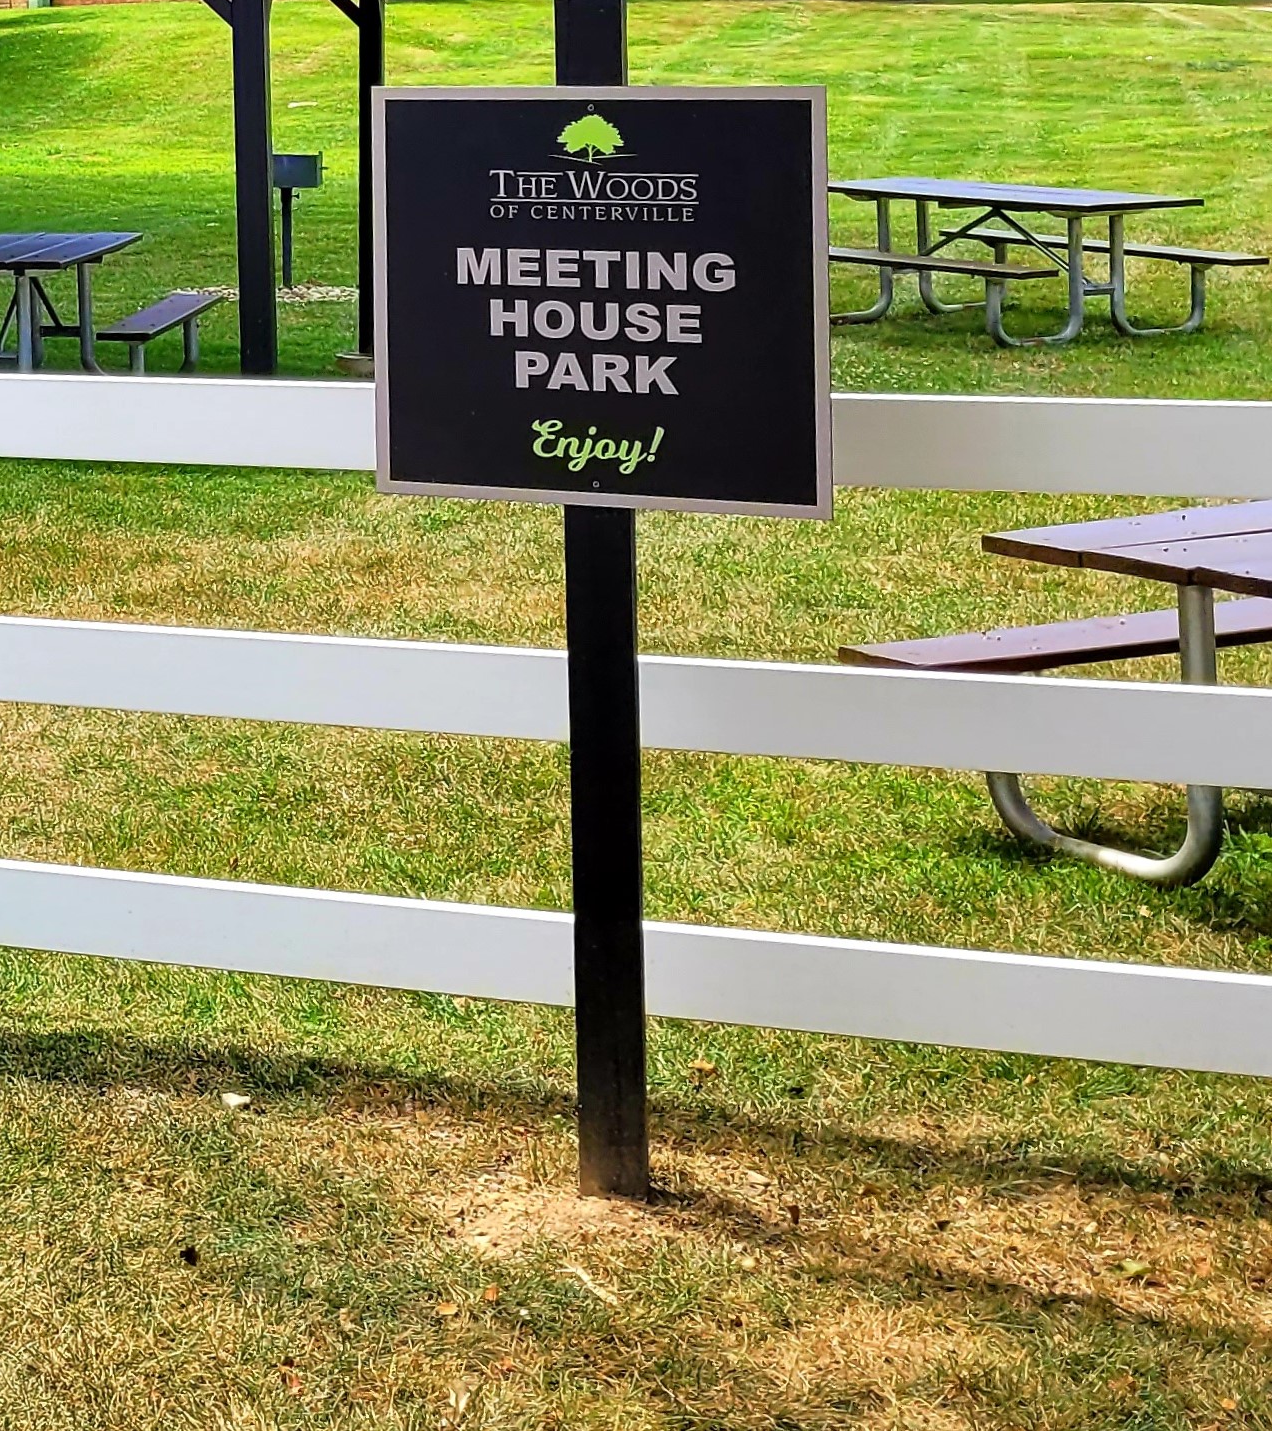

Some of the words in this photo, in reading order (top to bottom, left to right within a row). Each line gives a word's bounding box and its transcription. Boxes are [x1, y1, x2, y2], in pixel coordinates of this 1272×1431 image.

[489, 170, 558, 199] THE
[565, 171, 697, 200] WOODS
[490, 205, 520, 219] OF
[531, 205, 695, 222] CENTERVILLE
[456, 247, 737, 292] MEETING
[490, 300, 702, 344] HOUSE
[515, 351, 679, 395] PARK
[531, 419, 665, 476] Enjoy!
